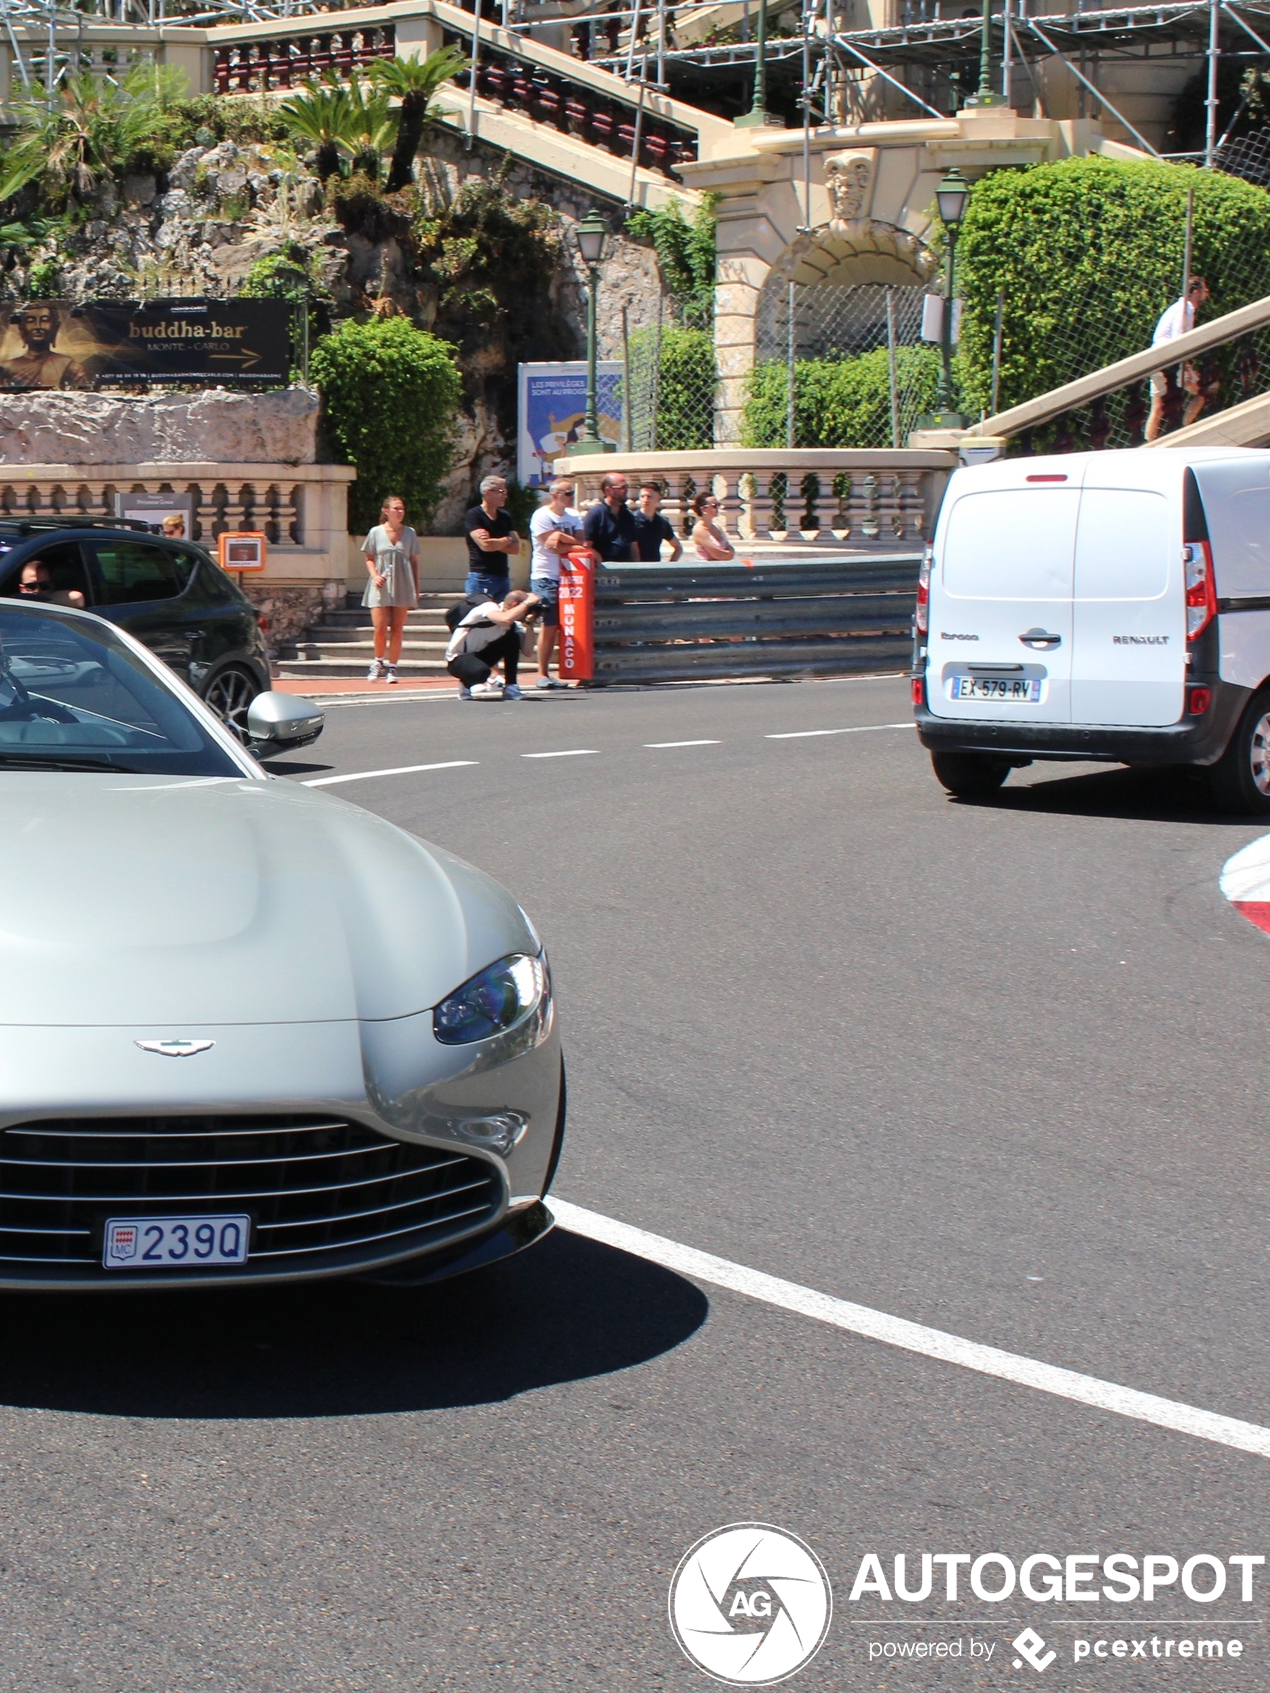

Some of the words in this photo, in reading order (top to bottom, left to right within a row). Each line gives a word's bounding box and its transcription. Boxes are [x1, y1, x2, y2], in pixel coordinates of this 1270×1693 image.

[129, 320, 244, 339] buddha-bar
[147, 342, 185, 351] MONTE
[193, 342, 230, 351] CARLO
[545, 379, 585, 388] PRIVILÈGES
[531, 388, 552, 396] SONT
[553, 388, 562, 396] AU
[559, 587, 583, 598] 2022
[563, 604, 575, 669] MONACO
[1112, 634, 1170, 645] RENAULT
[960, 680, 1030, 698] EX-579-RV
[115, 1244, 131, 1255] MC
[142, 1222, 240, 1260] 239Q
